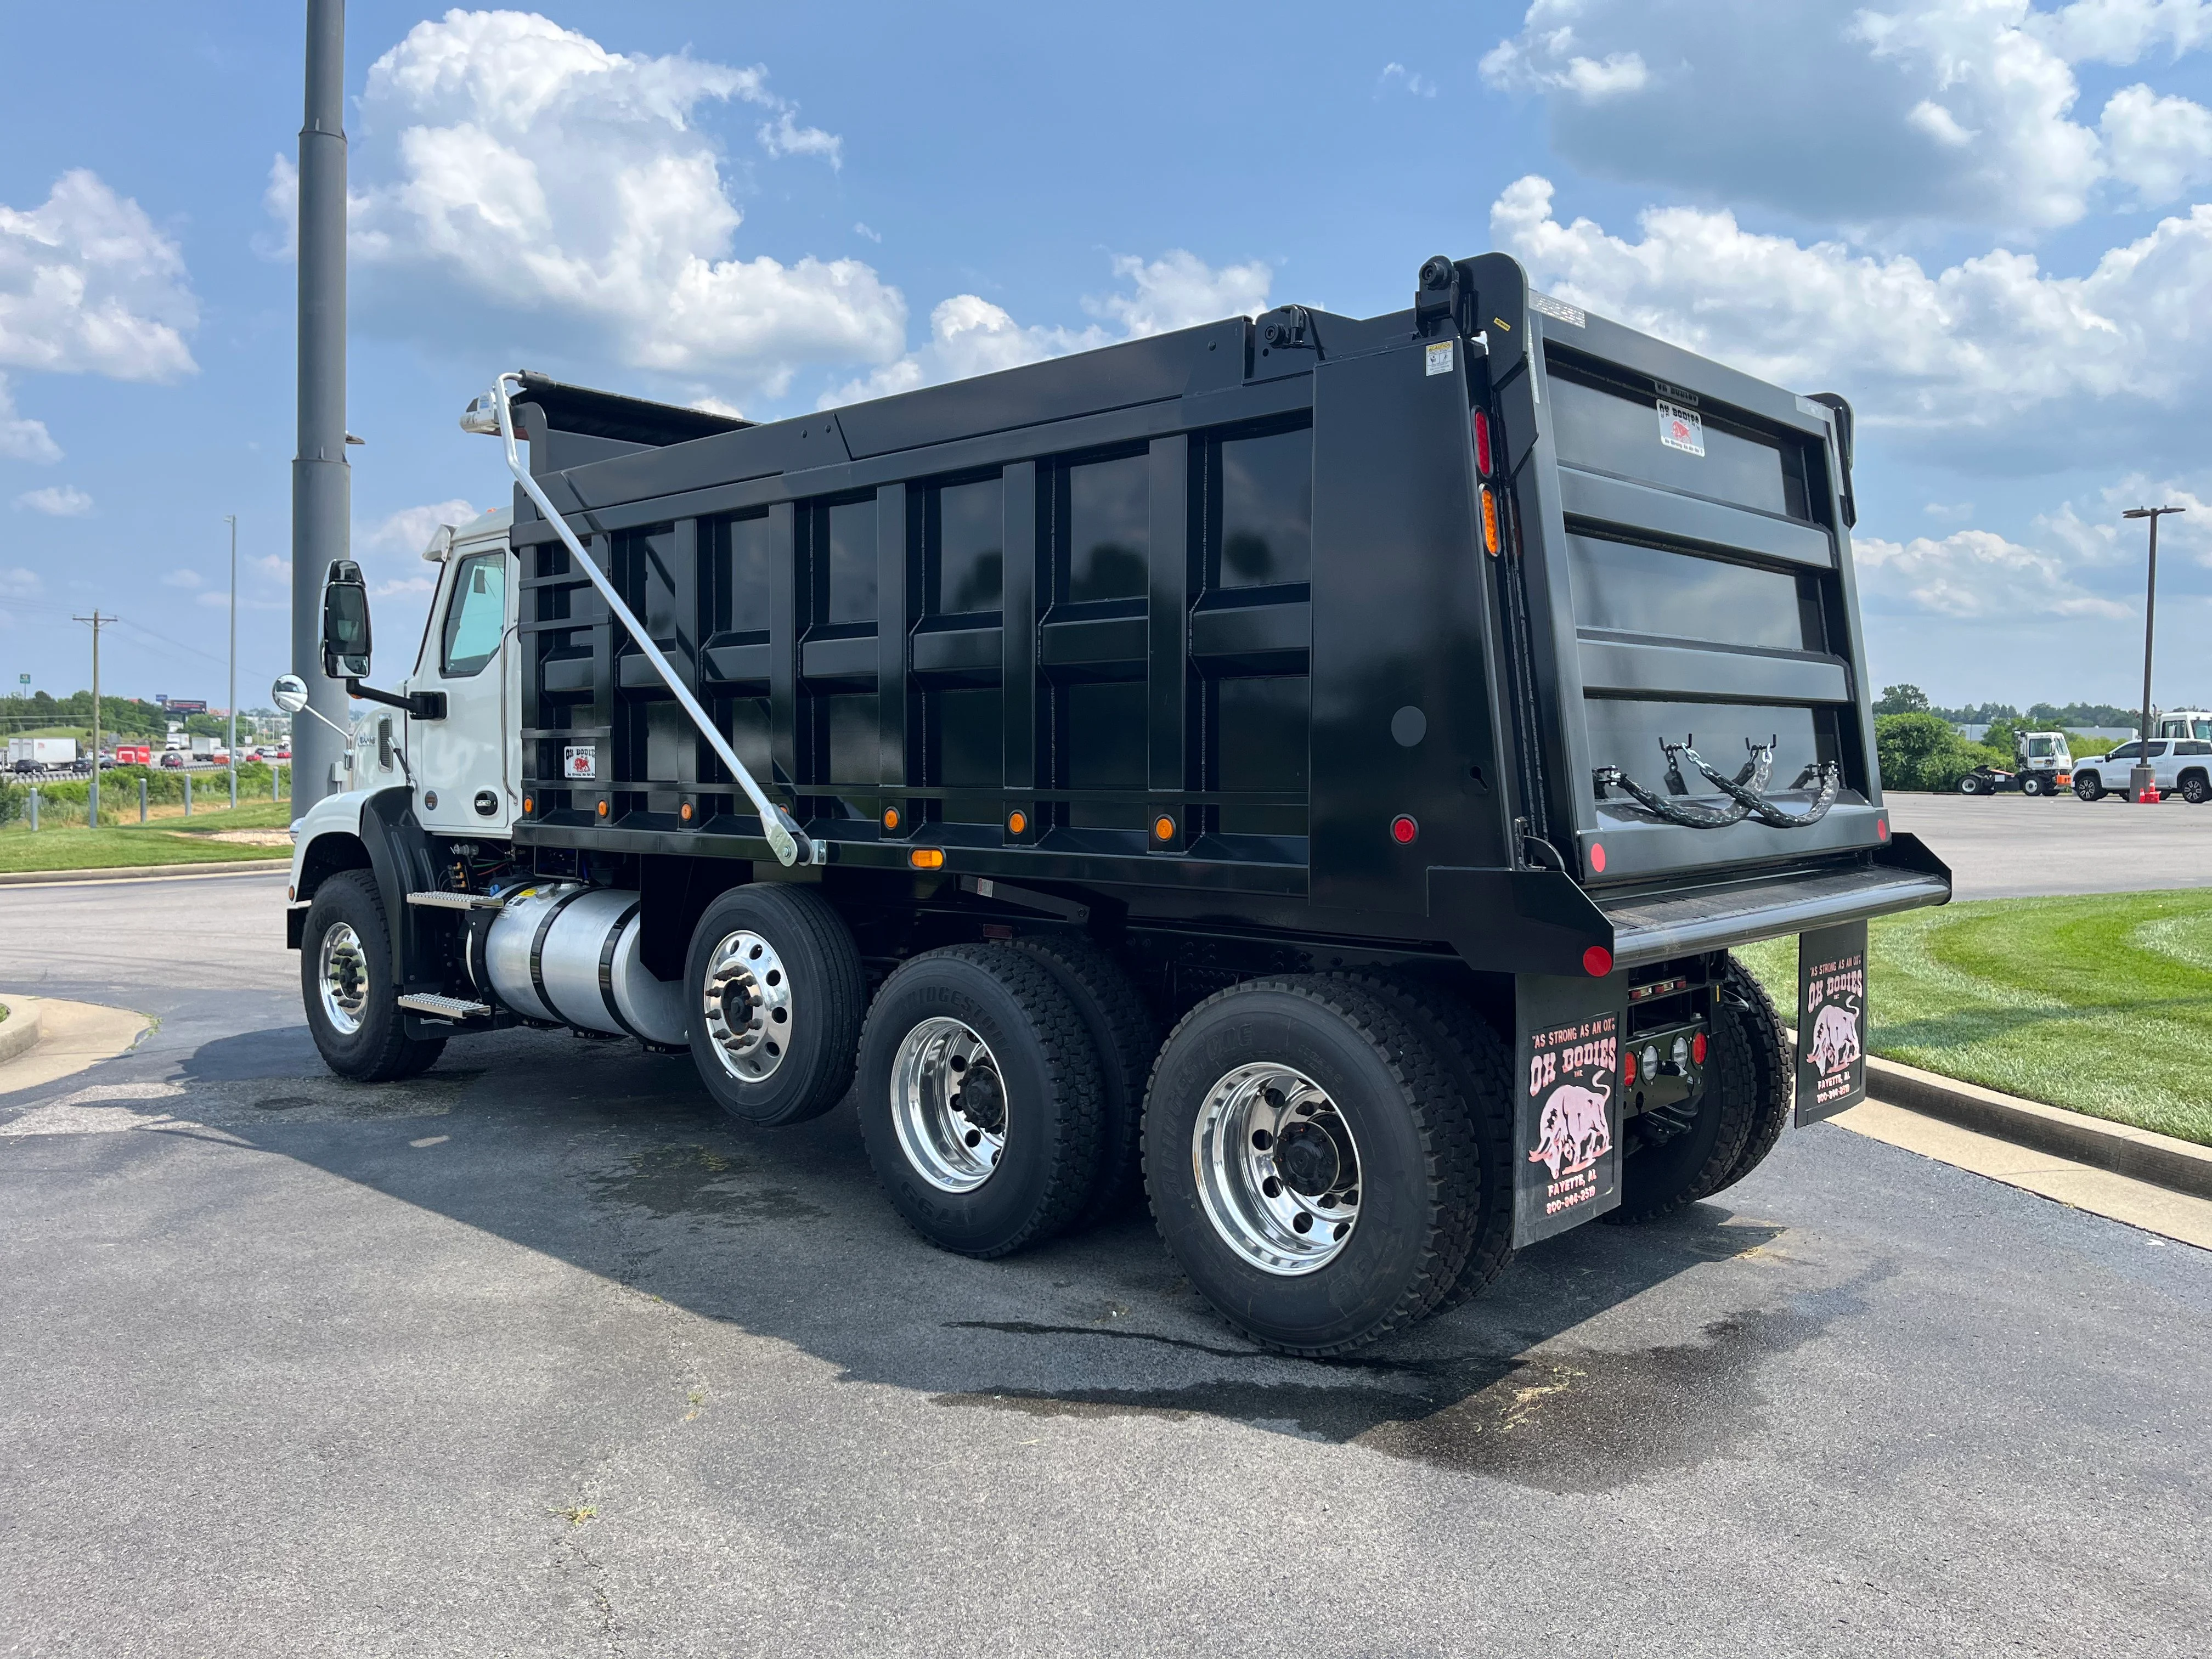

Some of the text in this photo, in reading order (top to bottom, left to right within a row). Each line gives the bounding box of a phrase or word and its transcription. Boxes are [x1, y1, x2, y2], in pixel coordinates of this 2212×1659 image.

[1659, 403, 1700, 431] OX BODIES
[566, 748, 595, 760] OX BODIE
[1819, 961, 1837, 975] STRONG
[1838, 959, 1844, 970] AS
[1846, 957, 1852, 968] AN
[1808, 969, 1863, 1013] OX BODIES
[1548, 1027, 1577, 1046] STRONG
[1579, 1024, 1589, 1038] AS
[1592, 1020, 1602, 1035] AN
[1530, 1036, 1616, 1097] OX BODIES
[1818, 1074, 1843, 1090] FAYETTE,
[1548, 1169, 1597, 1197] FAYETTE, AL
